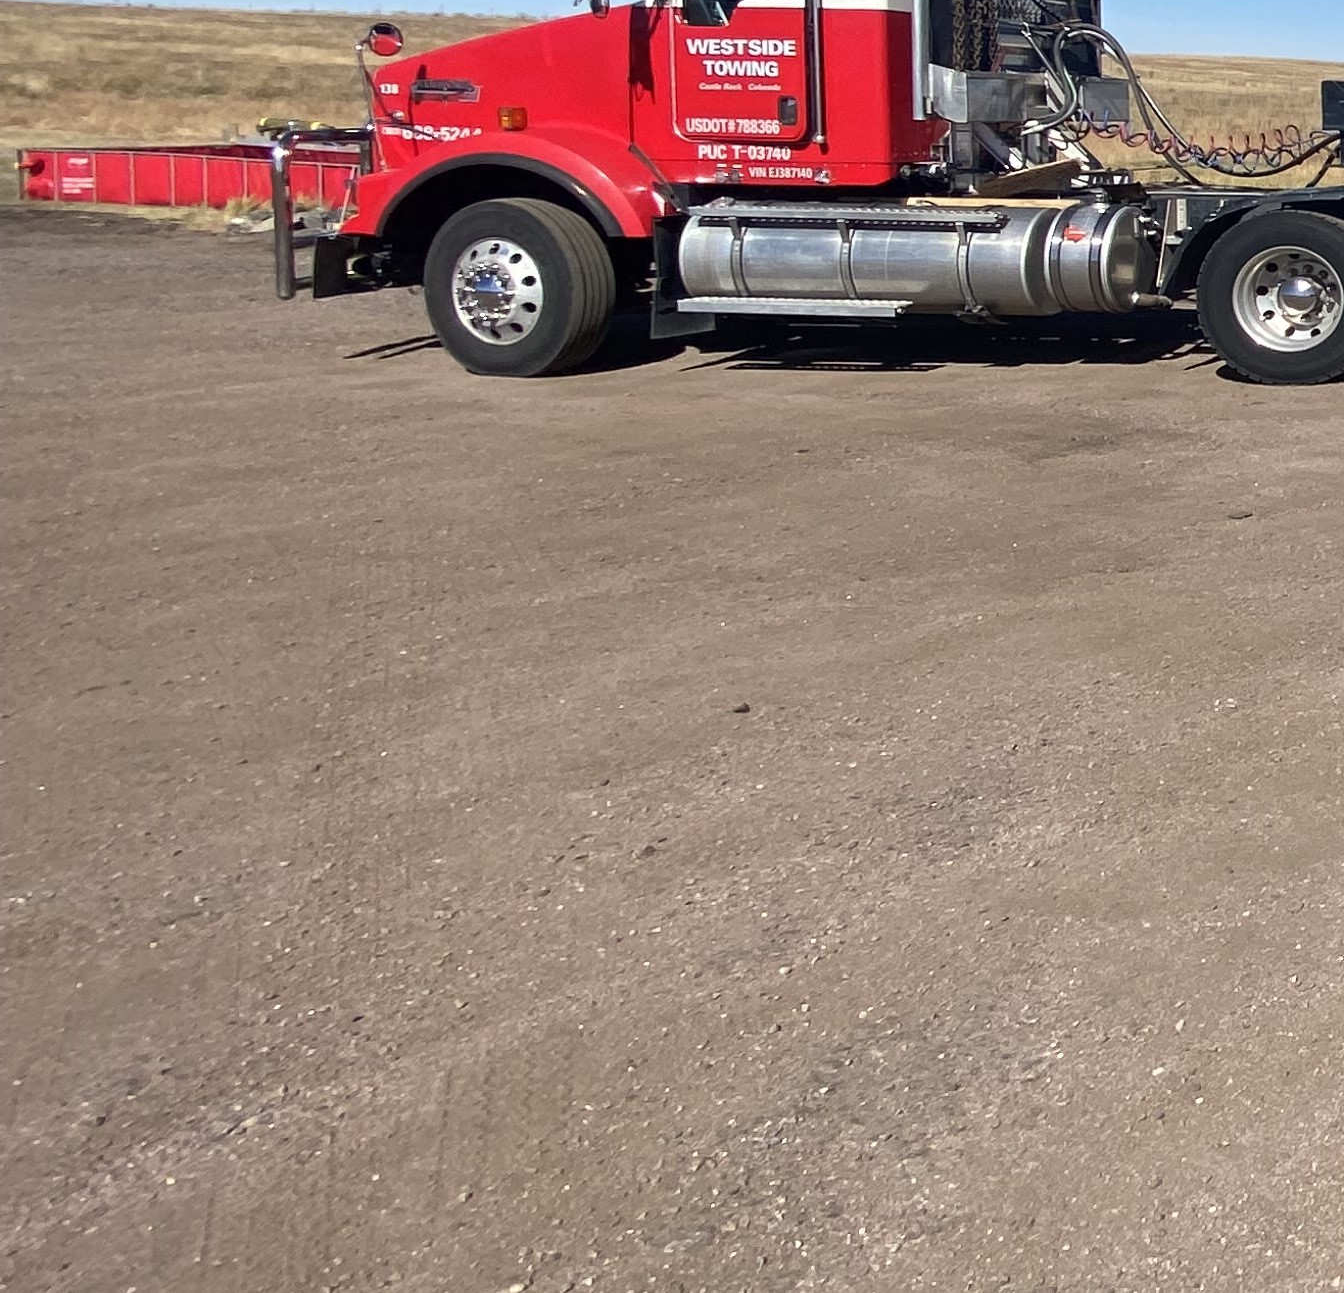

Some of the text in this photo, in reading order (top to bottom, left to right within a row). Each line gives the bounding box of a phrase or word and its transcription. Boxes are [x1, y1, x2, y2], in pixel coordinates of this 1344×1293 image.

[702, 59, 780, 77] TOWING
[685, 118, 781, 135] USDOT#788366
[698, 144, 792, 161] PUC T-03740
[748, 166, 767, 179] VIN
